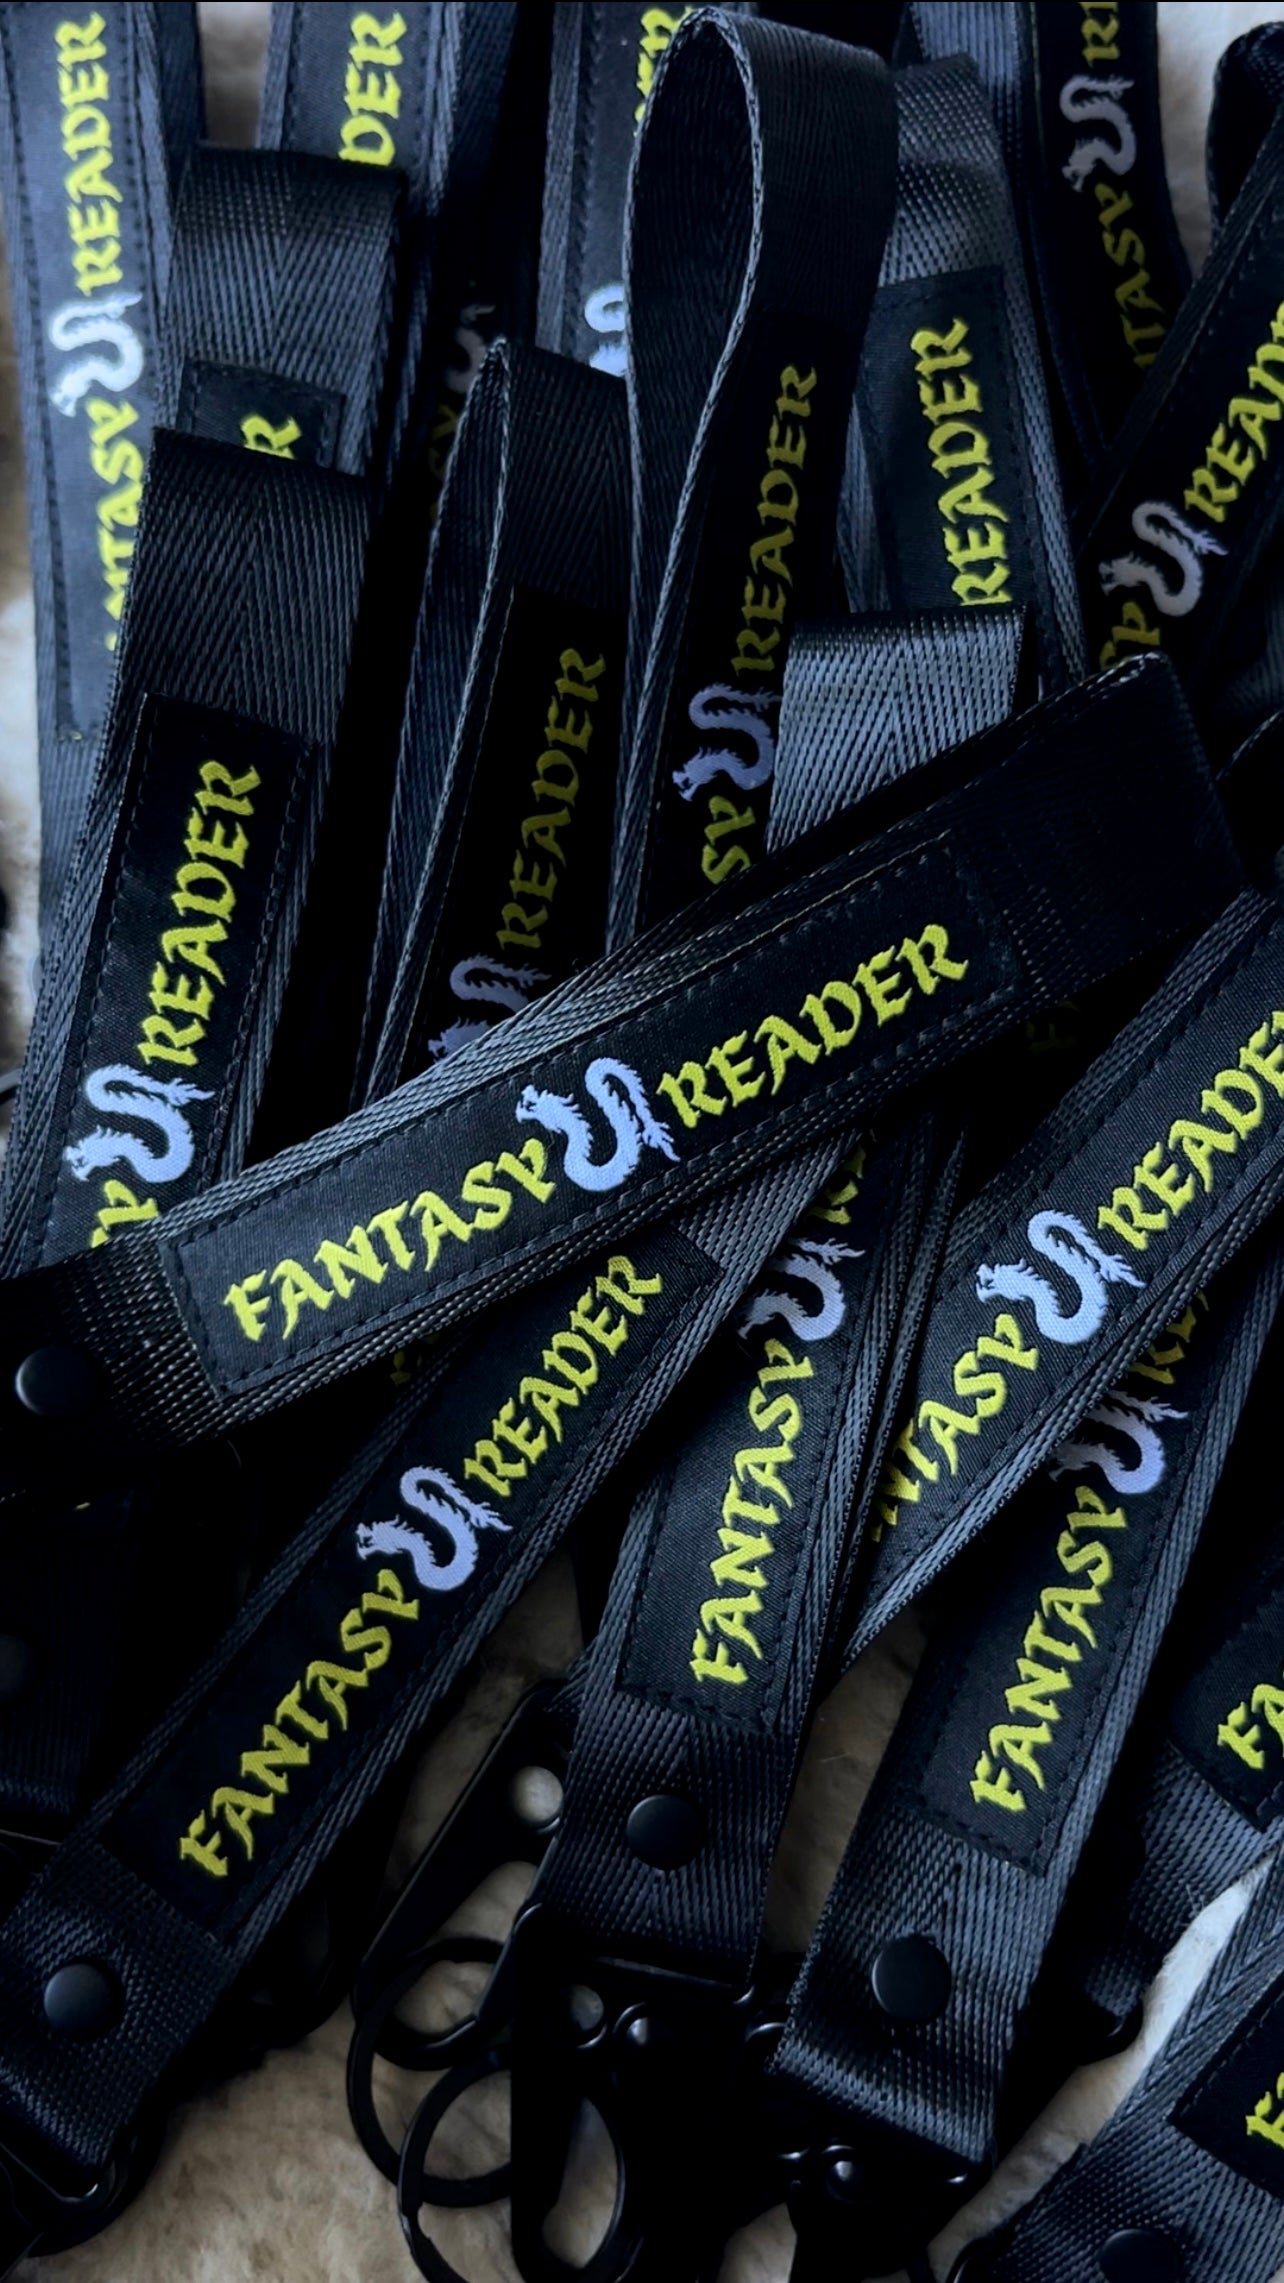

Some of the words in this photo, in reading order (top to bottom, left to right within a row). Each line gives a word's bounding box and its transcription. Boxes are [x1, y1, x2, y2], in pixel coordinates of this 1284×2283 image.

[55, 11, 122, 295] READER
[1094, 182, 1170, 368] TASY
[86, 398, 145, 652] TASY
[730, 363, 818, 676] READER
[910, 316, 1014, 607] READER
[1184, 300, 1284, 524] READ
[138, 759, 263, 1067] READER
[496, 647, 607, 951] READER
[223, 1138, 556, 1342] FANTASY
[656, 923, 970, 1130] READER
[1097, 1010, 1284, 1251] READE
[178, 1568, 421, 1878] FANTASY
[463, 1254, 664, 1498] READER
[689, 1337, 815, 1686] FANTASY
[969, 1484, 1128, 1813] FANTASY
